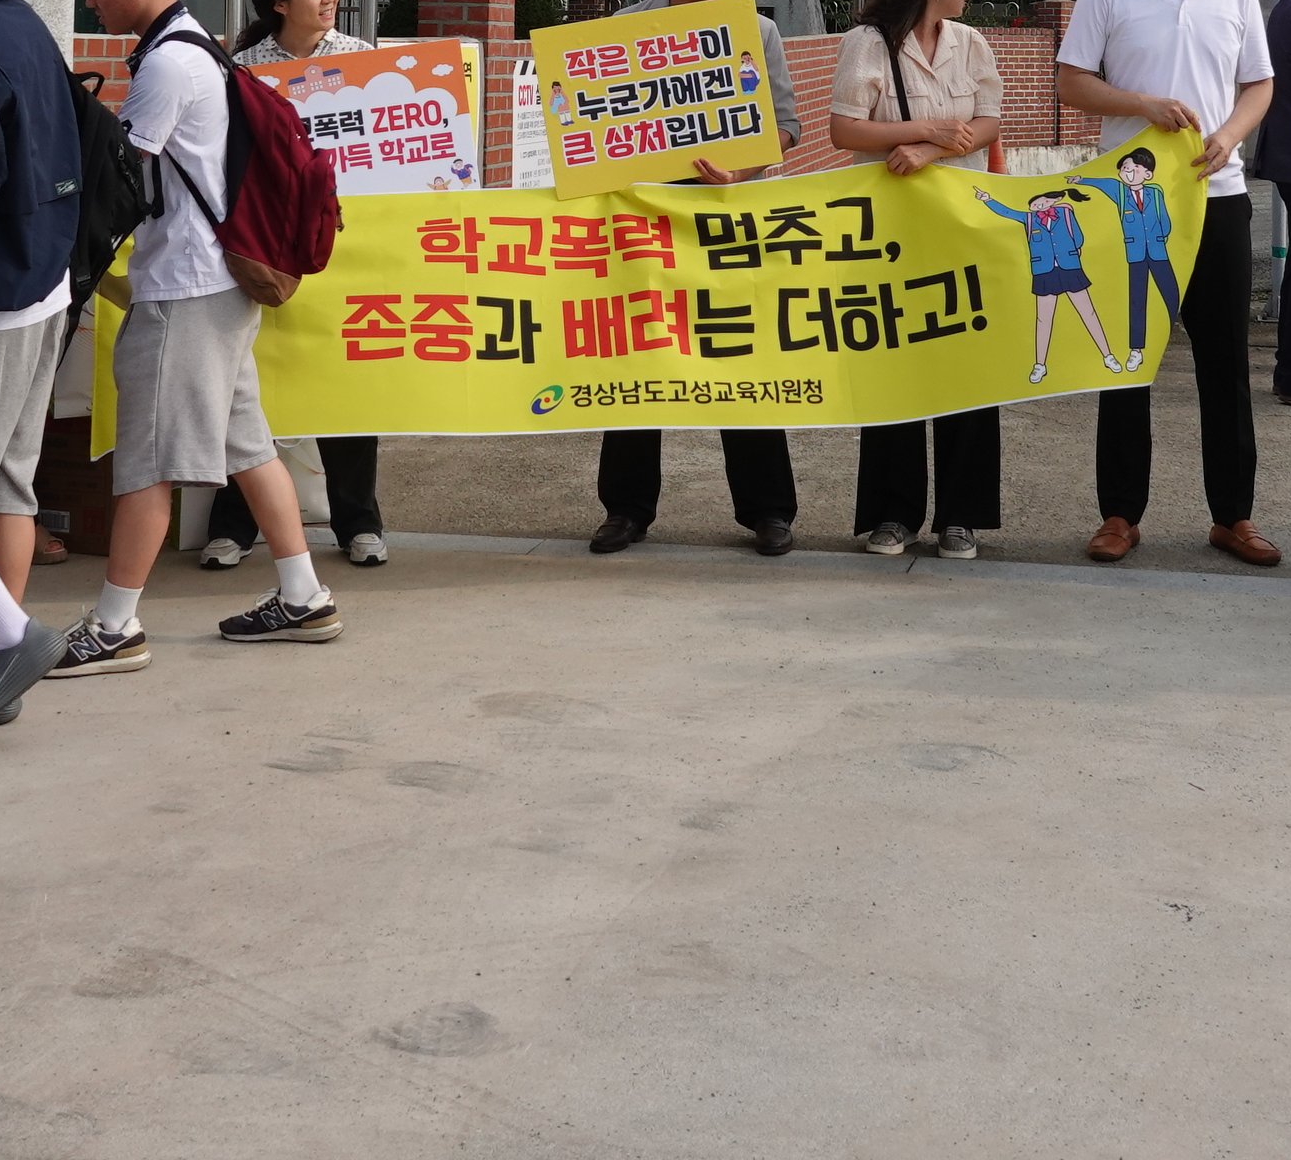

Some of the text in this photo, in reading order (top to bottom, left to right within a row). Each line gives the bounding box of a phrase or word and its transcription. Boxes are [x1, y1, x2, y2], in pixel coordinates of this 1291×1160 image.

[565, 25, 732, 80] 작은 장난이
[370, 99, 448, 134] ZERO,
[518, 84, 534, 106] CCTV
[576, 66, 735, 121] 누군가에겐
[378, 132, 456, 166] 학교로
[562, 103, 762, 166] 큰 상처입니다
[416, 196, 901, 278] 학교폭력 멈추고,
[341, 264, 988, 364] 존중과 배려는 더하고!
[570, 378, 824, 408] 경상남도고성교육지원청
